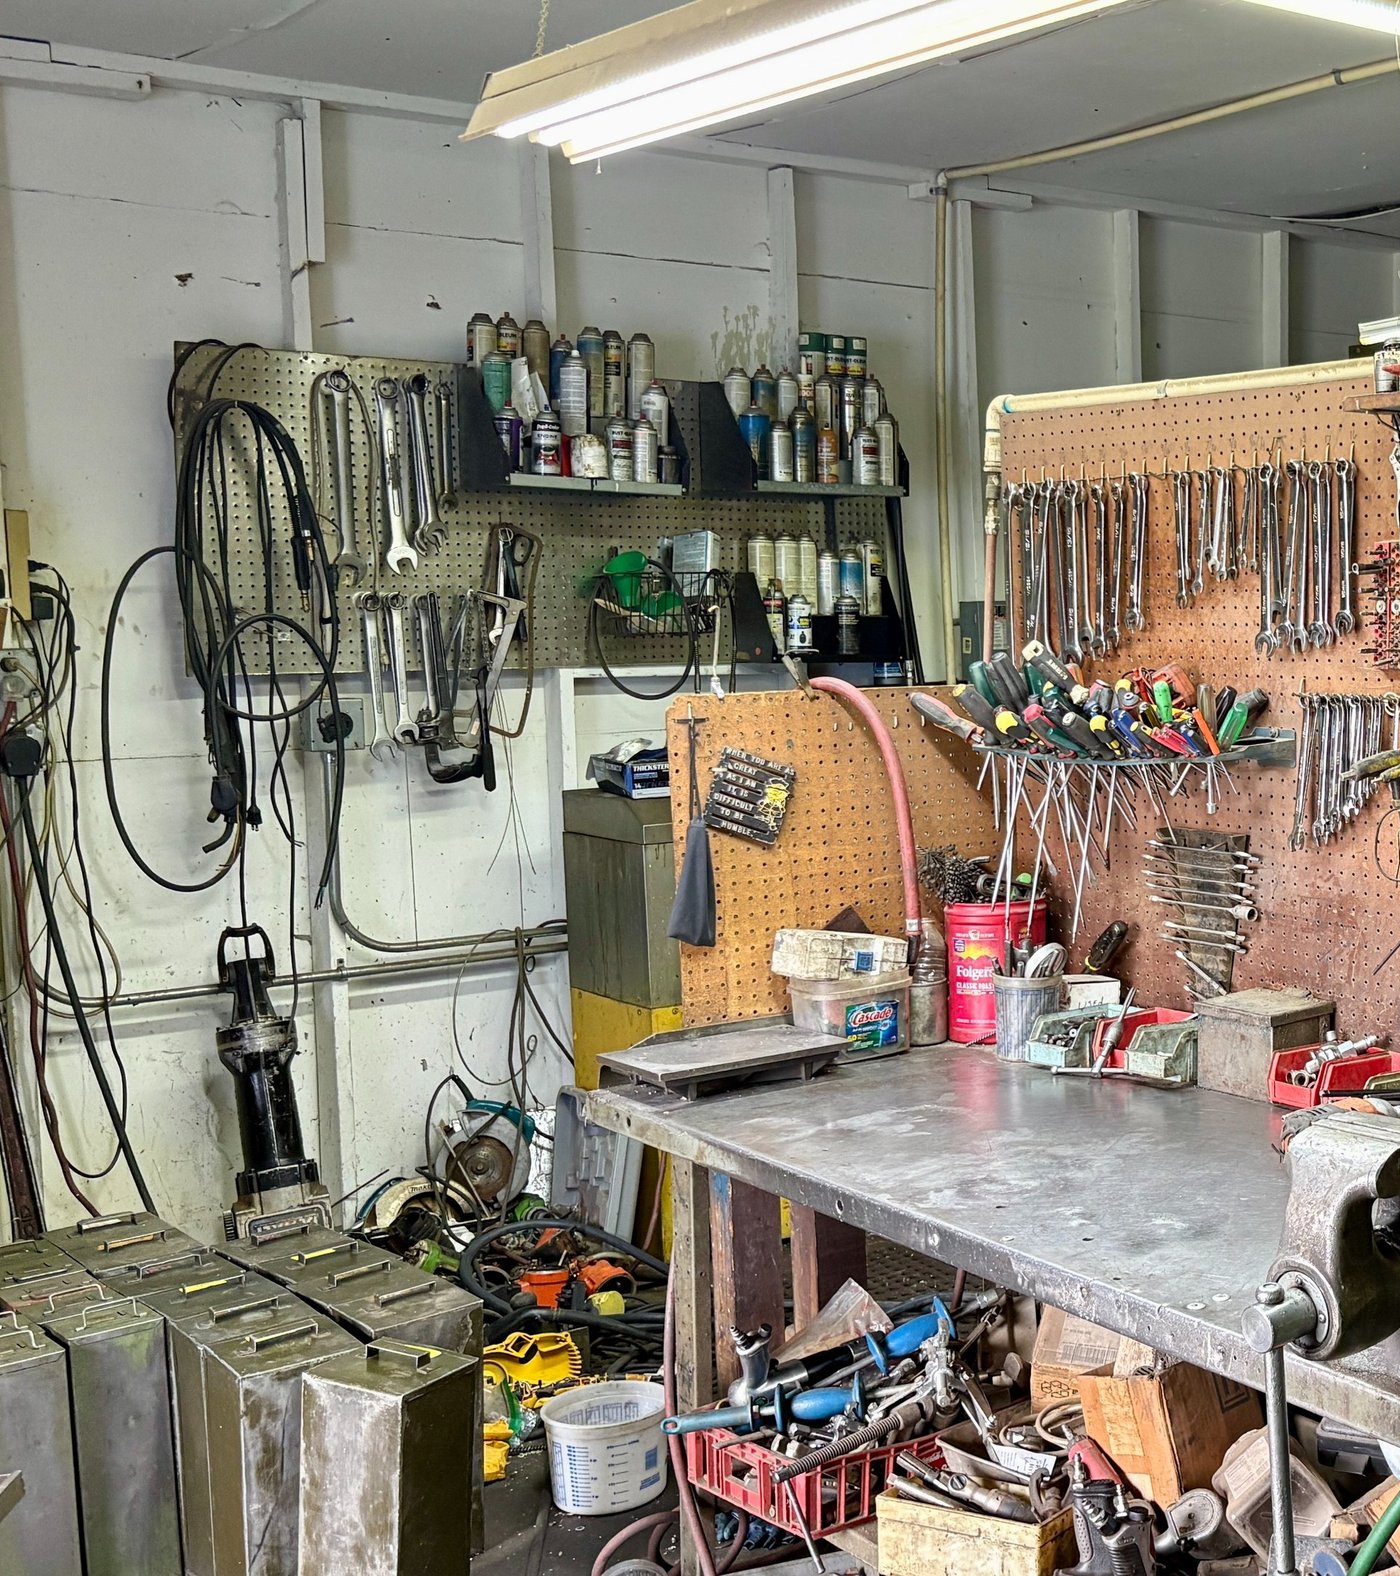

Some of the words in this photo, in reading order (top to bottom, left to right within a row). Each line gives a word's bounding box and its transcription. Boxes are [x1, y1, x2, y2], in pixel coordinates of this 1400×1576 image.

[726, 747, 746, 759] WHEN
[751, 755, 766, 766] YOU
[768, 760, 783, 771] ARE
[784, 765, 795, 776] AS
[734, 762, 757, 776] GREAT
[726, 772, 737, 781] AS
[745, 779, 757, 788] AM
[727, 786, 737, 795] IT
[740, 789, 749, 797] IS
[714, 792, 754, 811] DIFFICULT
[720, 807, 731, 816] TO
[734, 812, 744, 821] BE
[852, 1007, 893, 1026] Cascade
